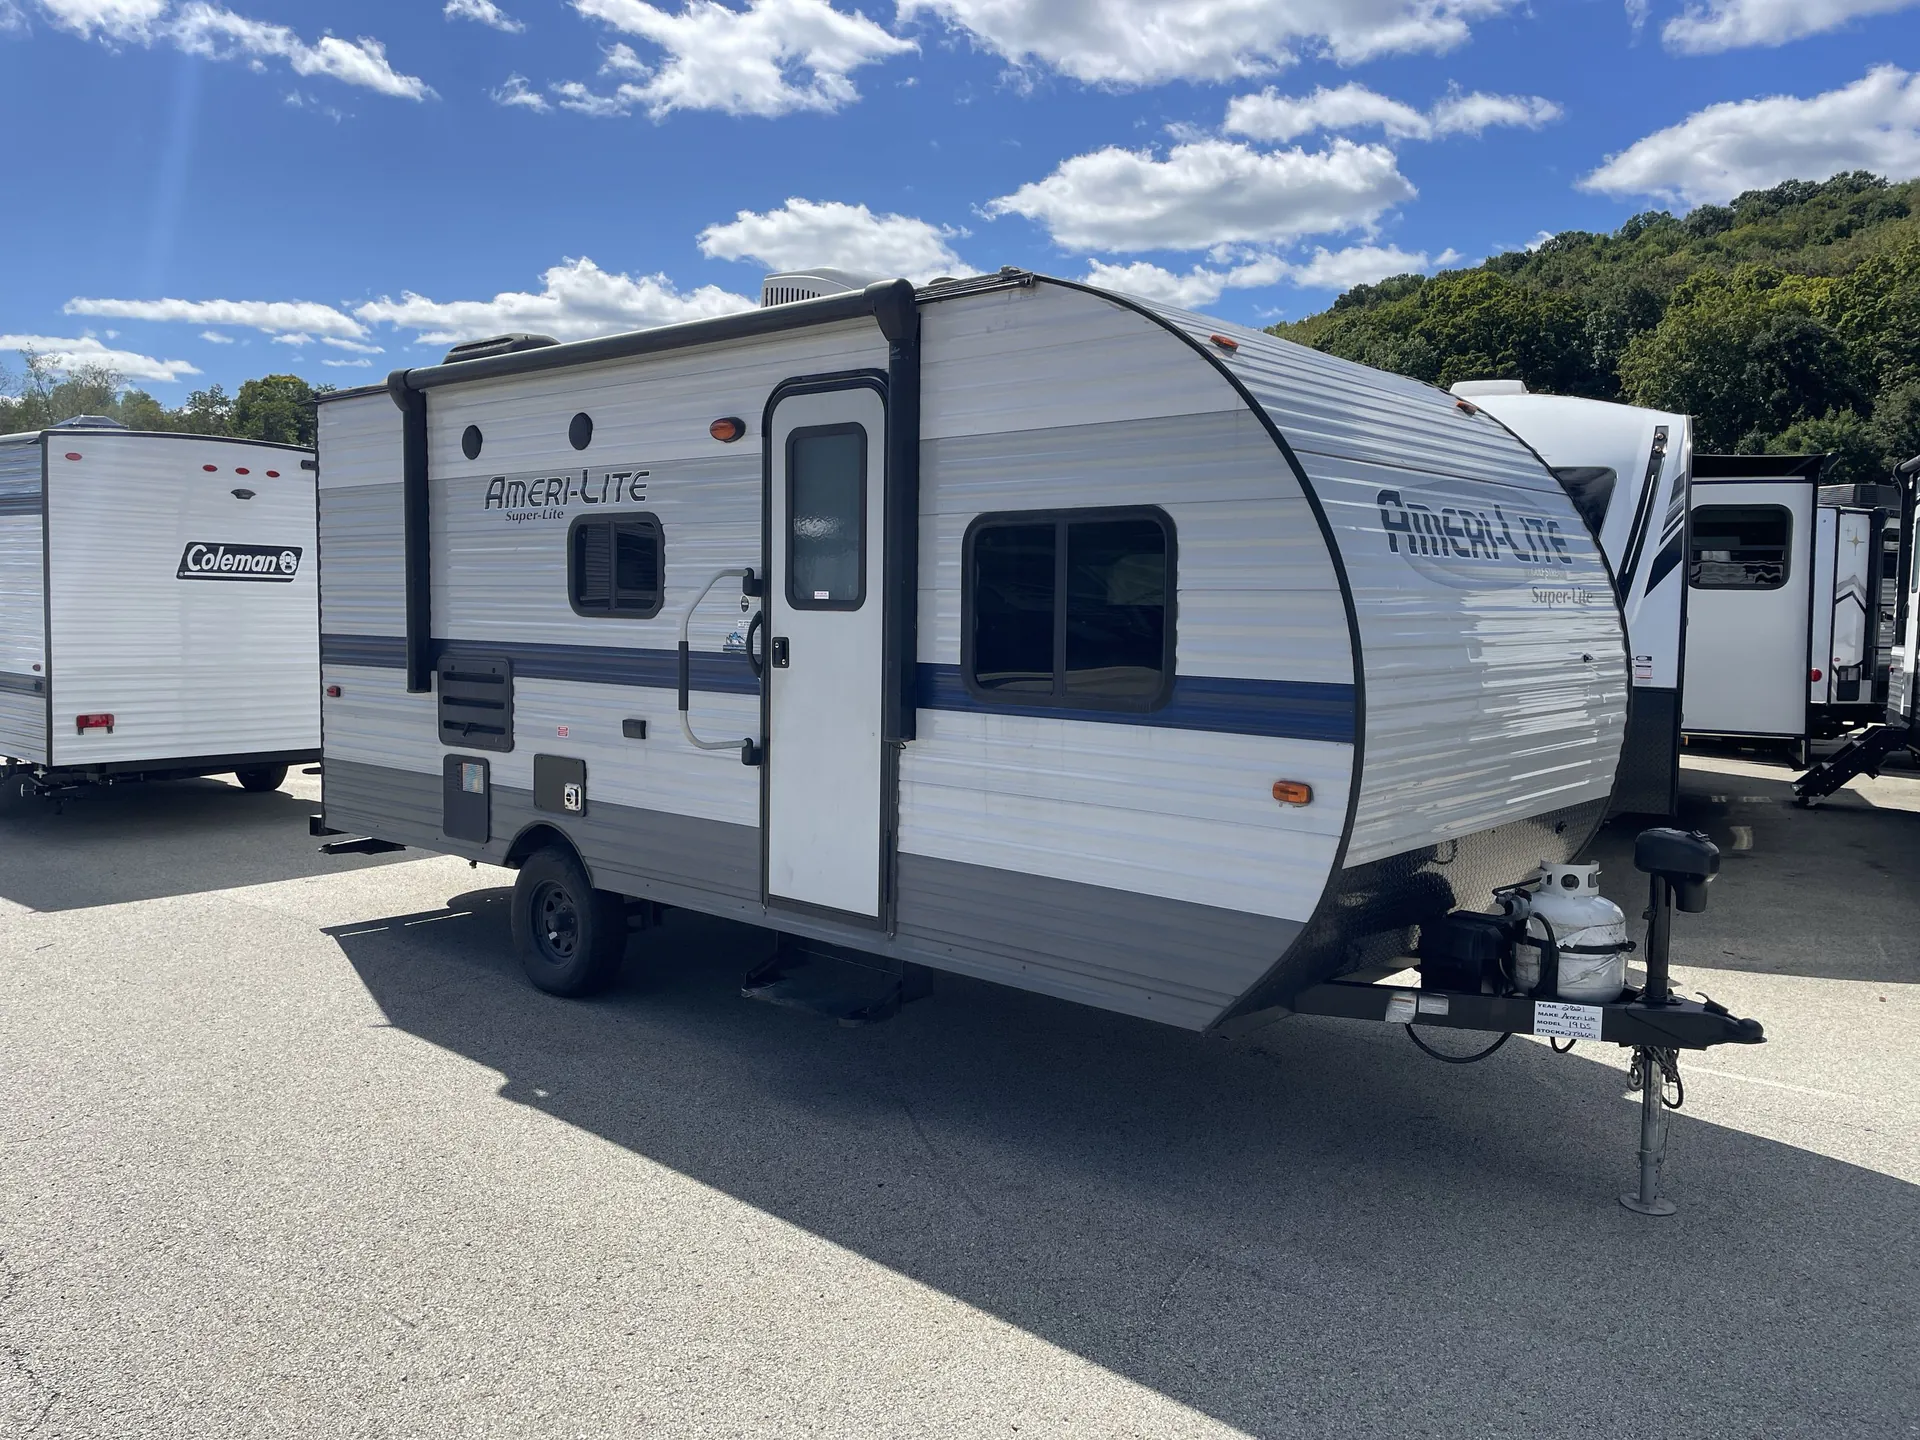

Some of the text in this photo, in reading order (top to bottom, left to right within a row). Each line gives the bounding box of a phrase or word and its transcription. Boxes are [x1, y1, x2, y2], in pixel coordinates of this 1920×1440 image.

[484, 468, 650, 510] AMERI-LITE
[505, 508, 564, 524] Super-Lite
[1376, 489, 1573, 565] AMERI-LITE
[187, 544, 277, 572] Coleman
[1531, 586, 1593, 608] Super-Lite
